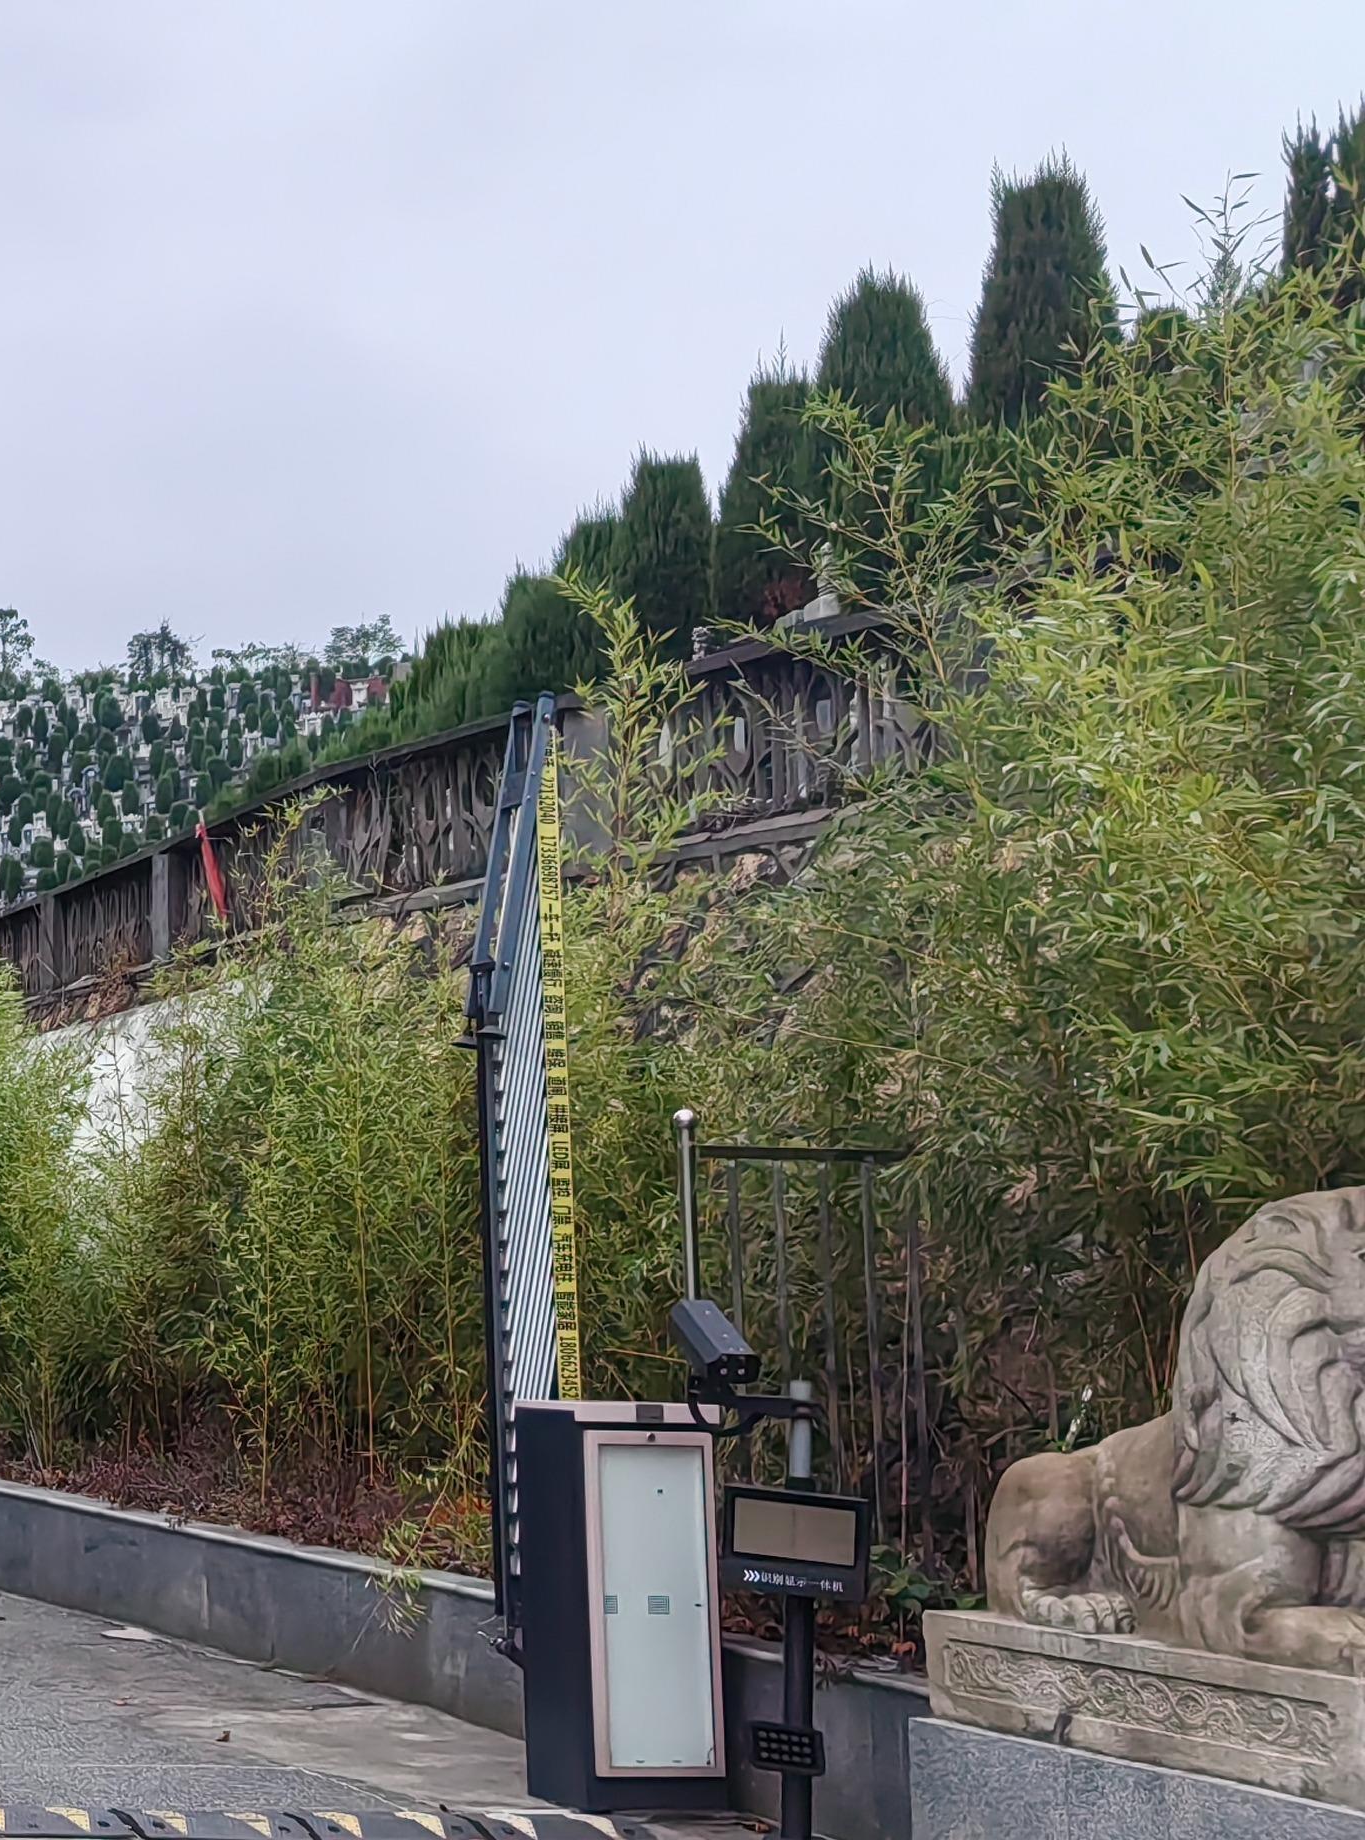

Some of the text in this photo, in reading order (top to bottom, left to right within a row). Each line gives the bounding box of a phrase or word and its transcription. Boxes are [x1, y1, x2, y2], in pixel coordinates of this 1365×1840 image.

[761, 1571, 844, 1592] 识别显示一体机
